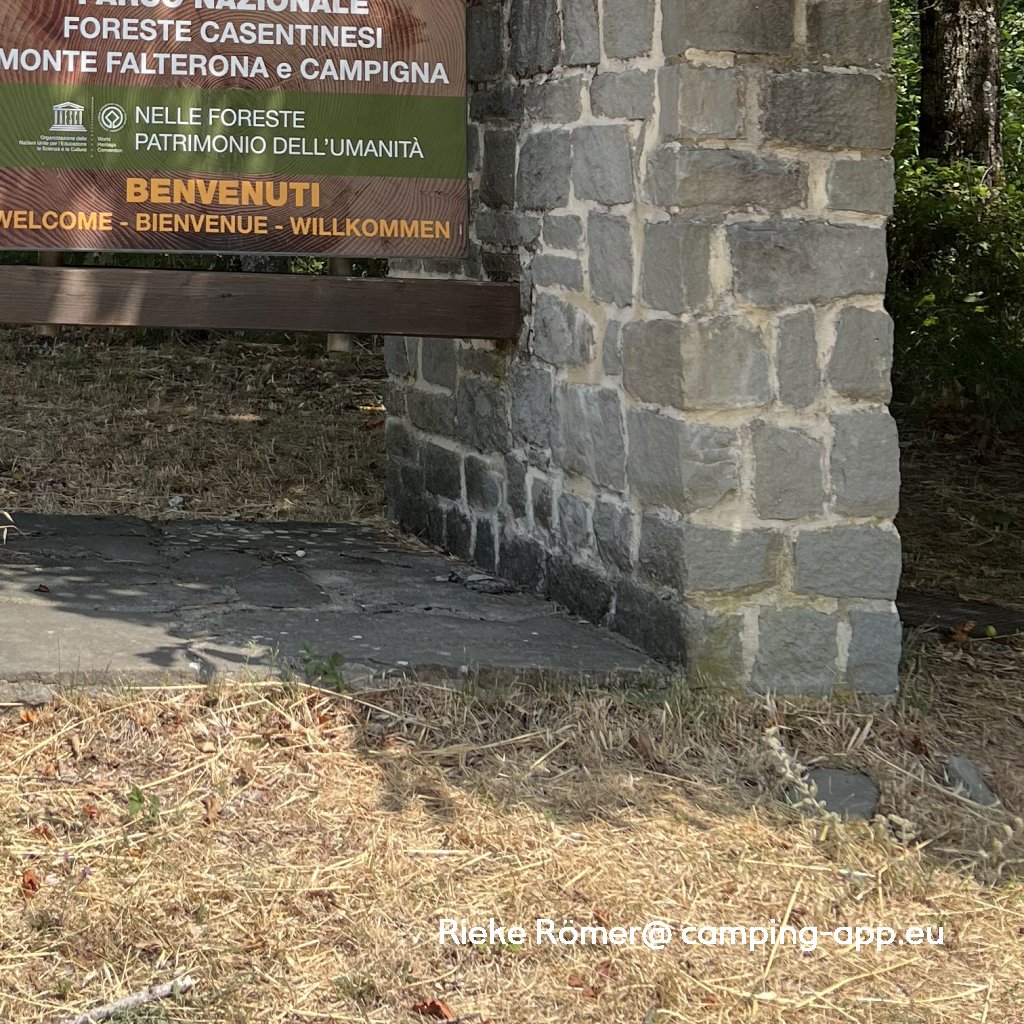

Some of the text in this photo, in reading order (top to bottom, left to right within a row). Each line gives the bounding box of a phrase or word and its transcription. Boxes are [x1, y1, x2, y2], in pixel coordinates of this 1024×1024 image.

[63, 17, 382, 49] FORESTE CASENTINESI
[106, 52, 269, 79] FALTERONA
[277, 61, 292, 79] e
[299, 58, 450, 84] CAMPIGNA
[135, 105, 202, 126] NELLE
[208, 107, 305, 129] FORESTE
[135, 133, 424, 159] PATRIMONIO DELL'UMANITÀ
[126, 178, 320, 207] BENVENUTI
[136, 214, 268, 235] BIENVENUE
[290, 217, 451, 239] WILLKOMMEN
